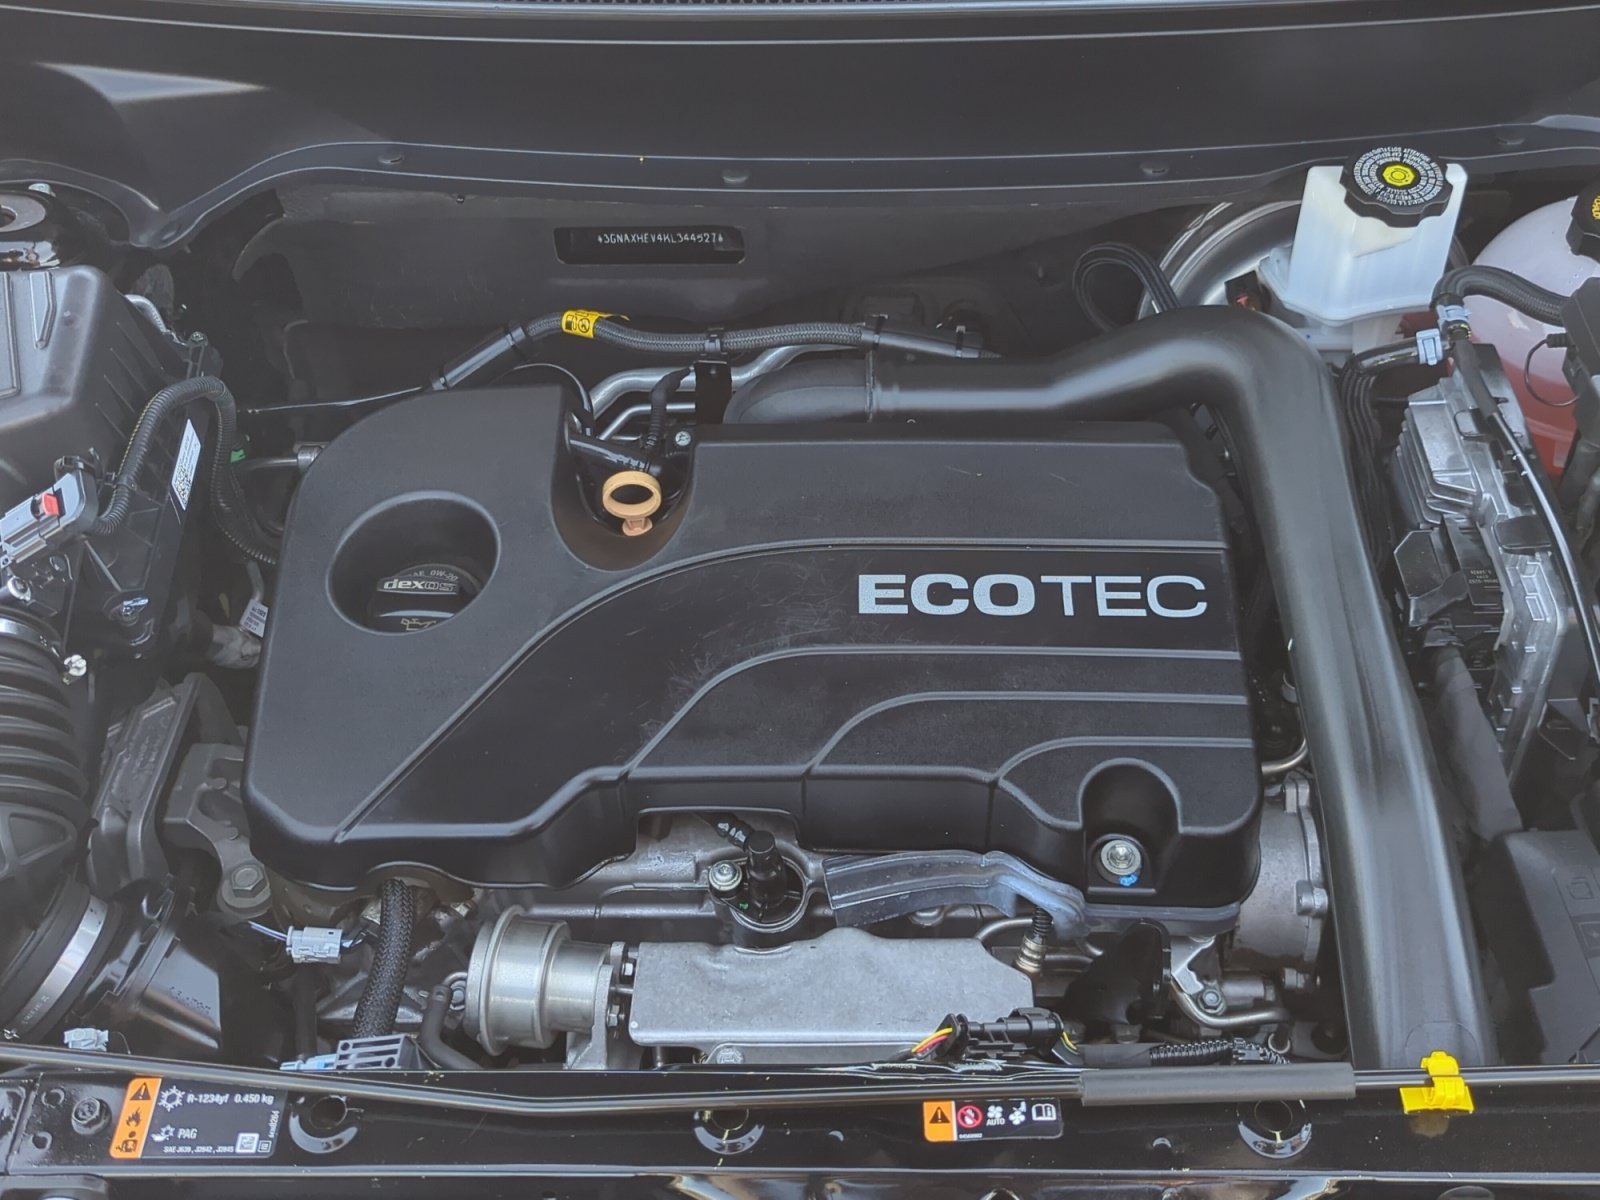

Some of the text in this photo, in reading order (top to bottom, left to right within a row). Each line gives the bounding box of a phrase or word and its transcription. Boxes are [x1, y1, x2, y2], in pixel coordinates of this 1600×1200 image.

[430, 569, 458, 581] 0W-20
[383, 578, 456, 592] dexos
[858, 573, 1208, 618] ECOTEC
[186, 1093, 275, 1105] R-1234yf 0.450 kg
[986, 1118, 1005, 1126] AUTO
[177, 1128, 198, 1139] PAG
